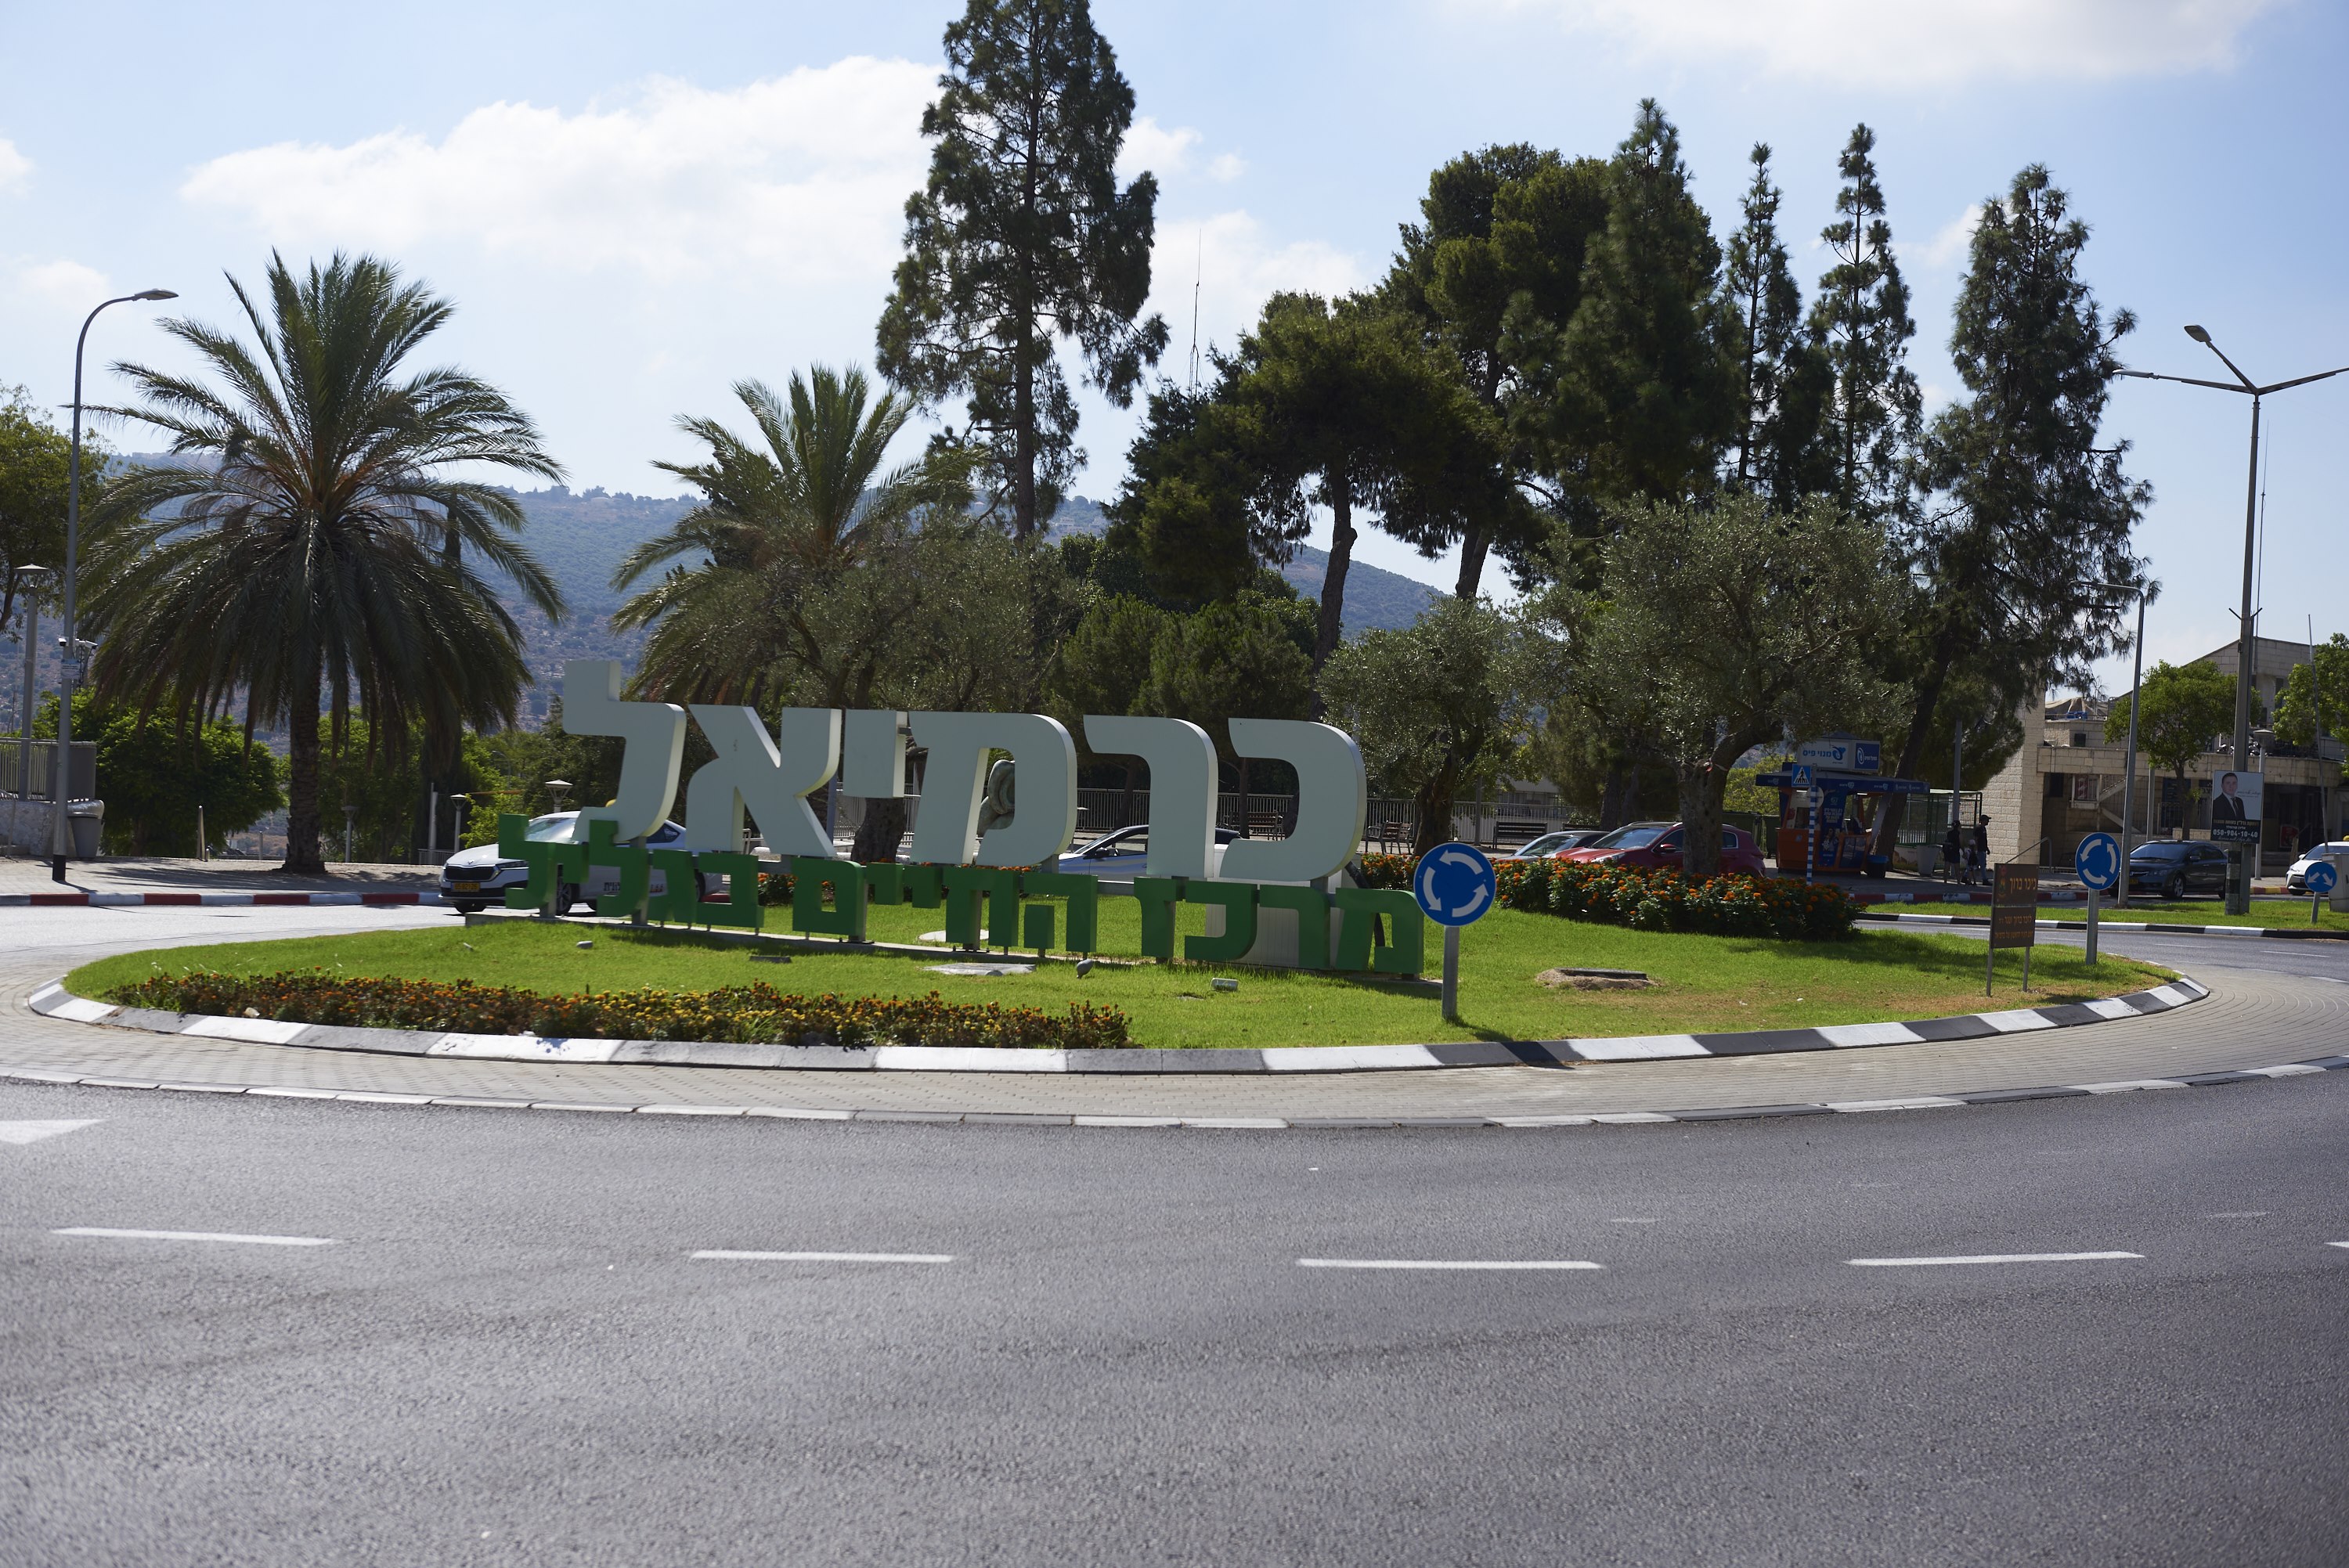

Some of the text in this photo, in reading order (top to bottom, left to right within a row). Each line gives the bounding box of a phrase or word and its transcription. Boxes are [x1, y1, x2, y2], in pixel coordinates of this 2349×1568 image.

[563, 660, 1366, 881] כרמיאל
[2213, 828, 2258, 838] 050-904-10-40
[498, 813, 1424, 974] מרכז החיים בגליל
[2009, 878, 2037, 895] כיכר ברוך
